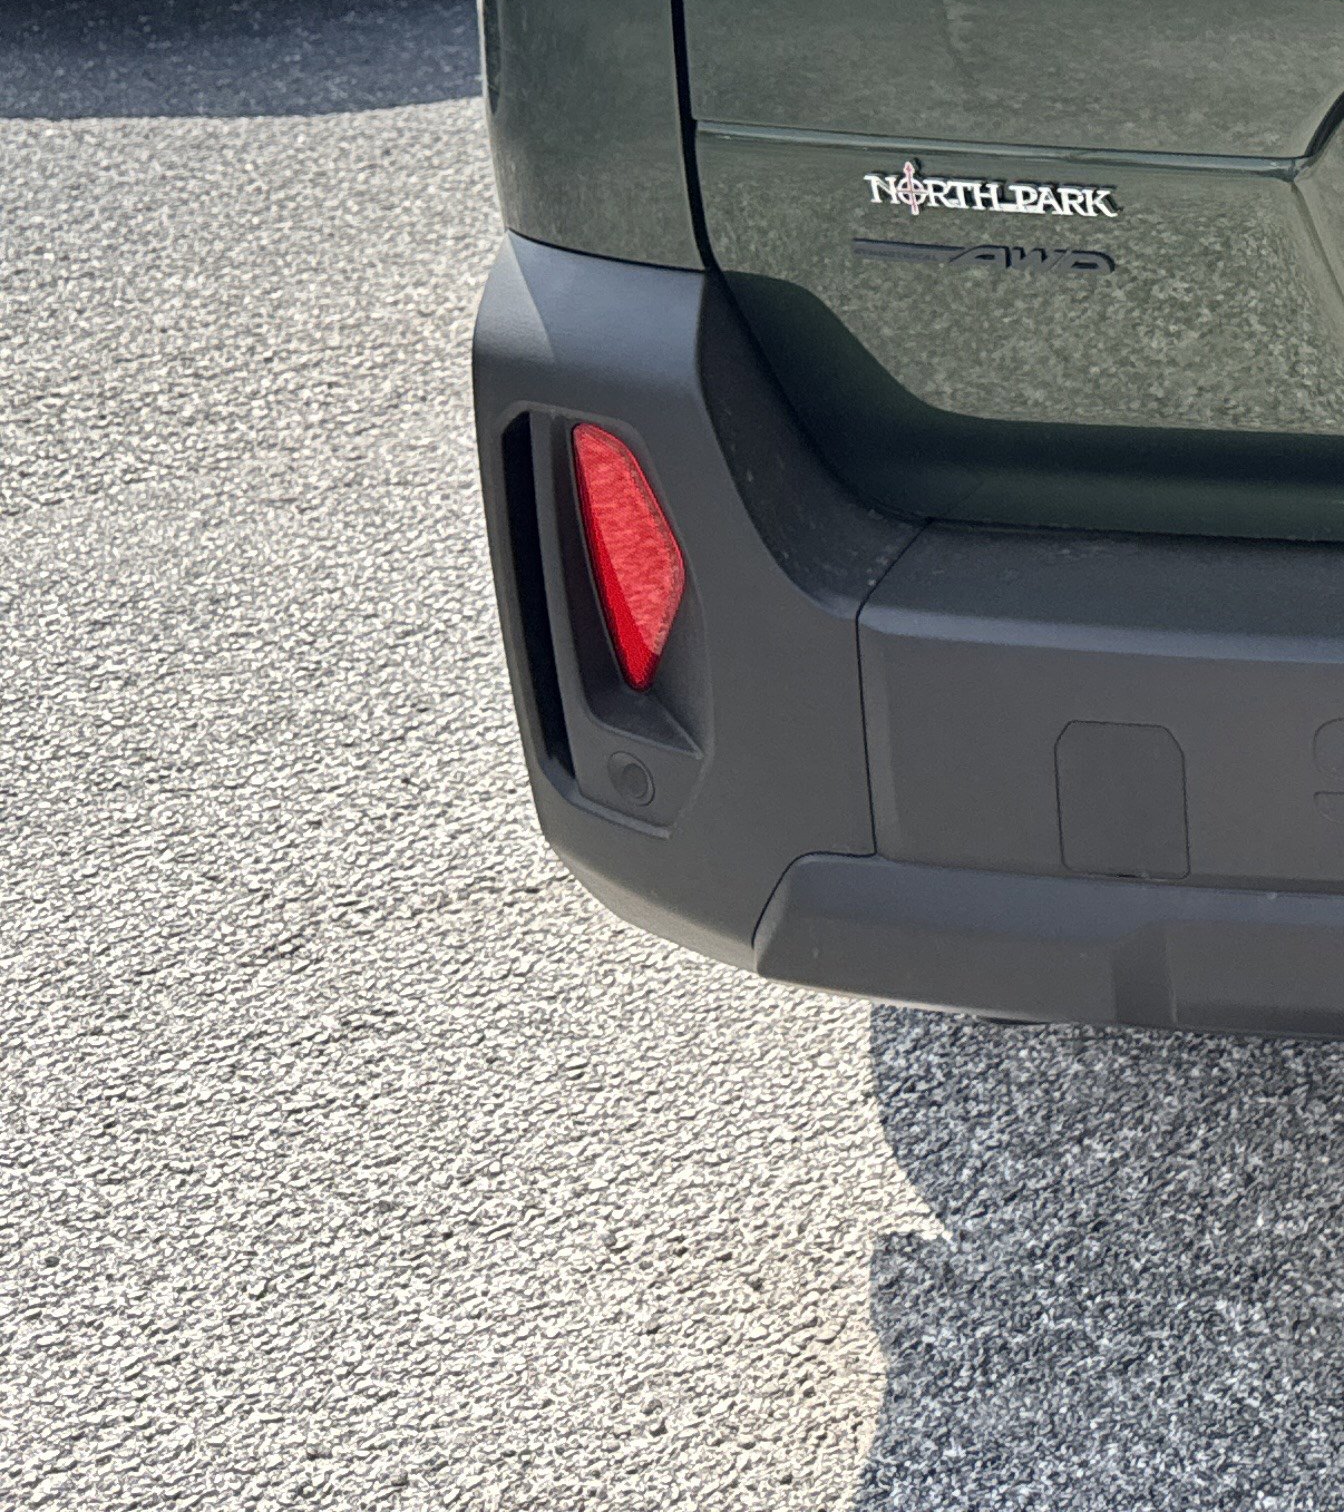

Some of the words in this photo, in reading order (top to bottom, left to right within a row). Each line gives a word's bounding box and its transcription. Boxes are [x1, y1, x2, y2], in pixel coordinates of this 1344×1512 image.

[863, 170, 1001, 215] NORTH
[1007, 184, 1119, 217] PARK
[949, 243, 1116, 273] AWD
